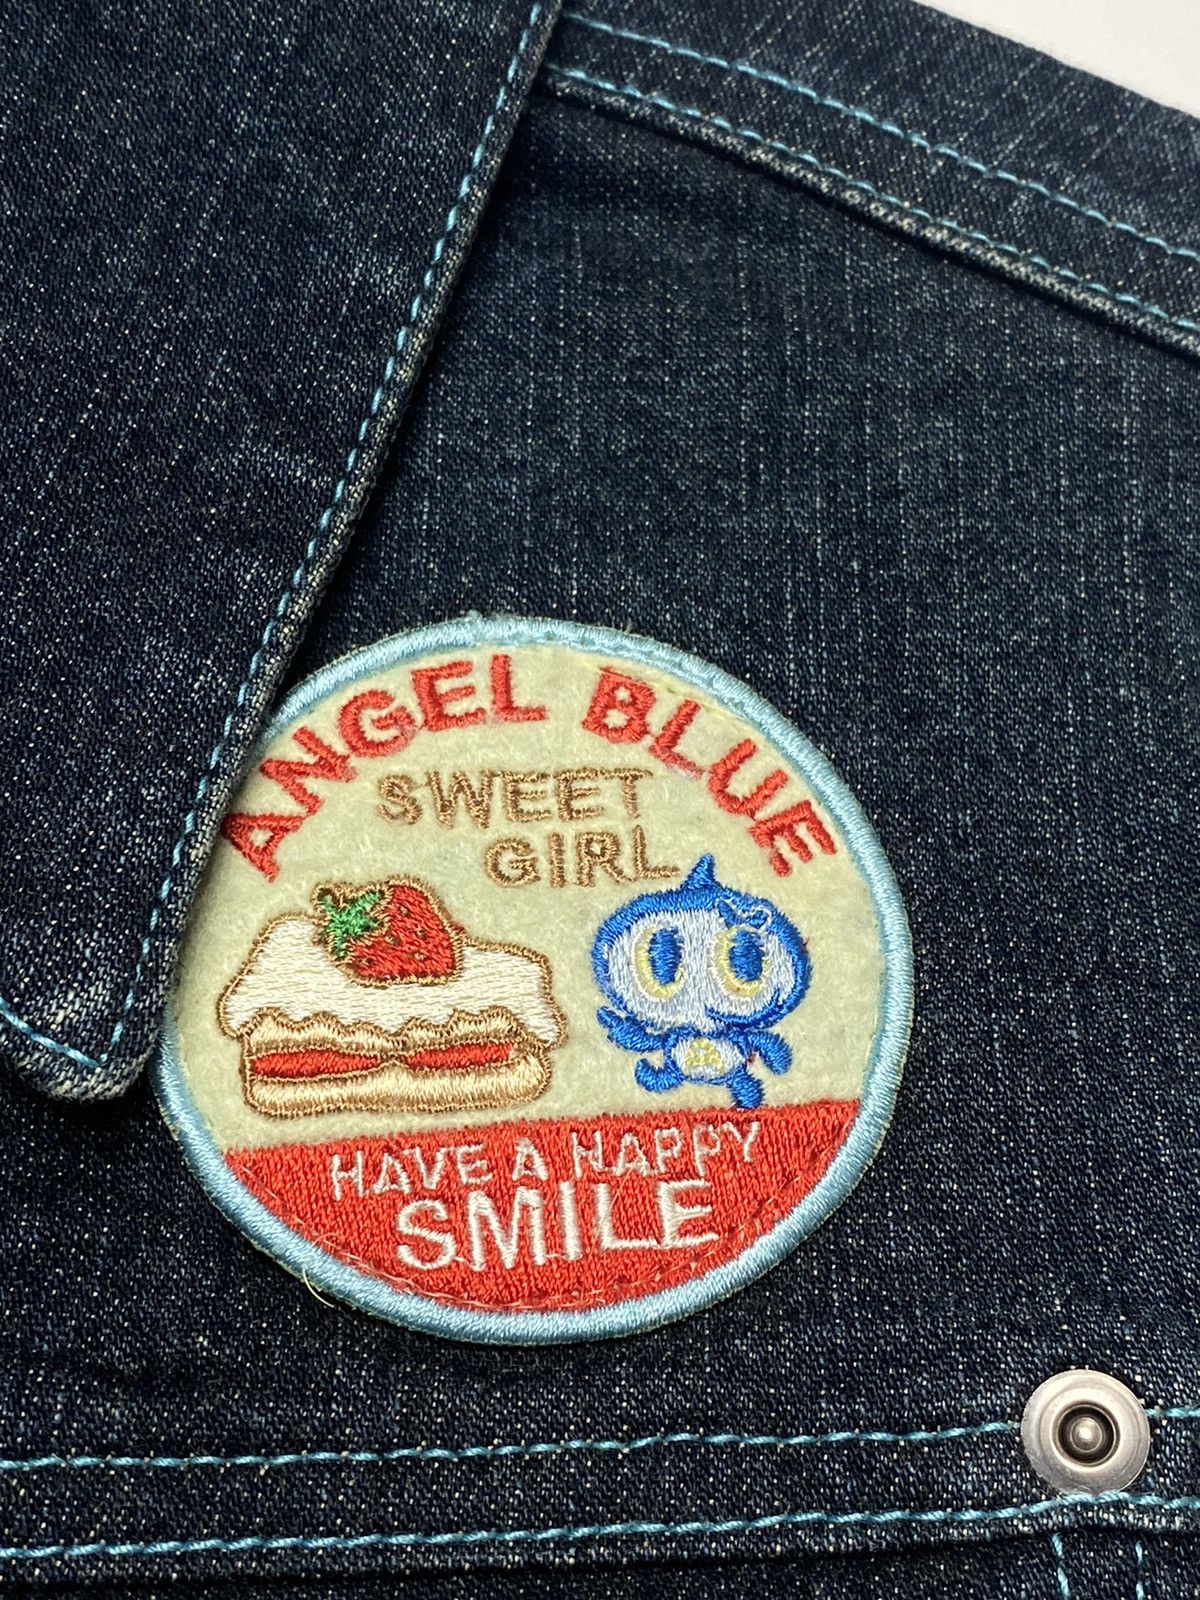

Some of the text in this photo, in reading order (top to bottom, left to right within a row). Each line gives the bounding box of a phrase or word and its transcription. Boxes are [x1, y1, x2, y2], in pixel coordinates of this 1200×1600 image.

[220, 653, 837, 883] ANGEL BLUE
[376, 766, 653, 830] SWEET
[484, 824, 681, 888] GIRL
[330, 1120, 760, 1200] HAVE A HAPPY
[396, 1179, 720, 1271] SMILE
